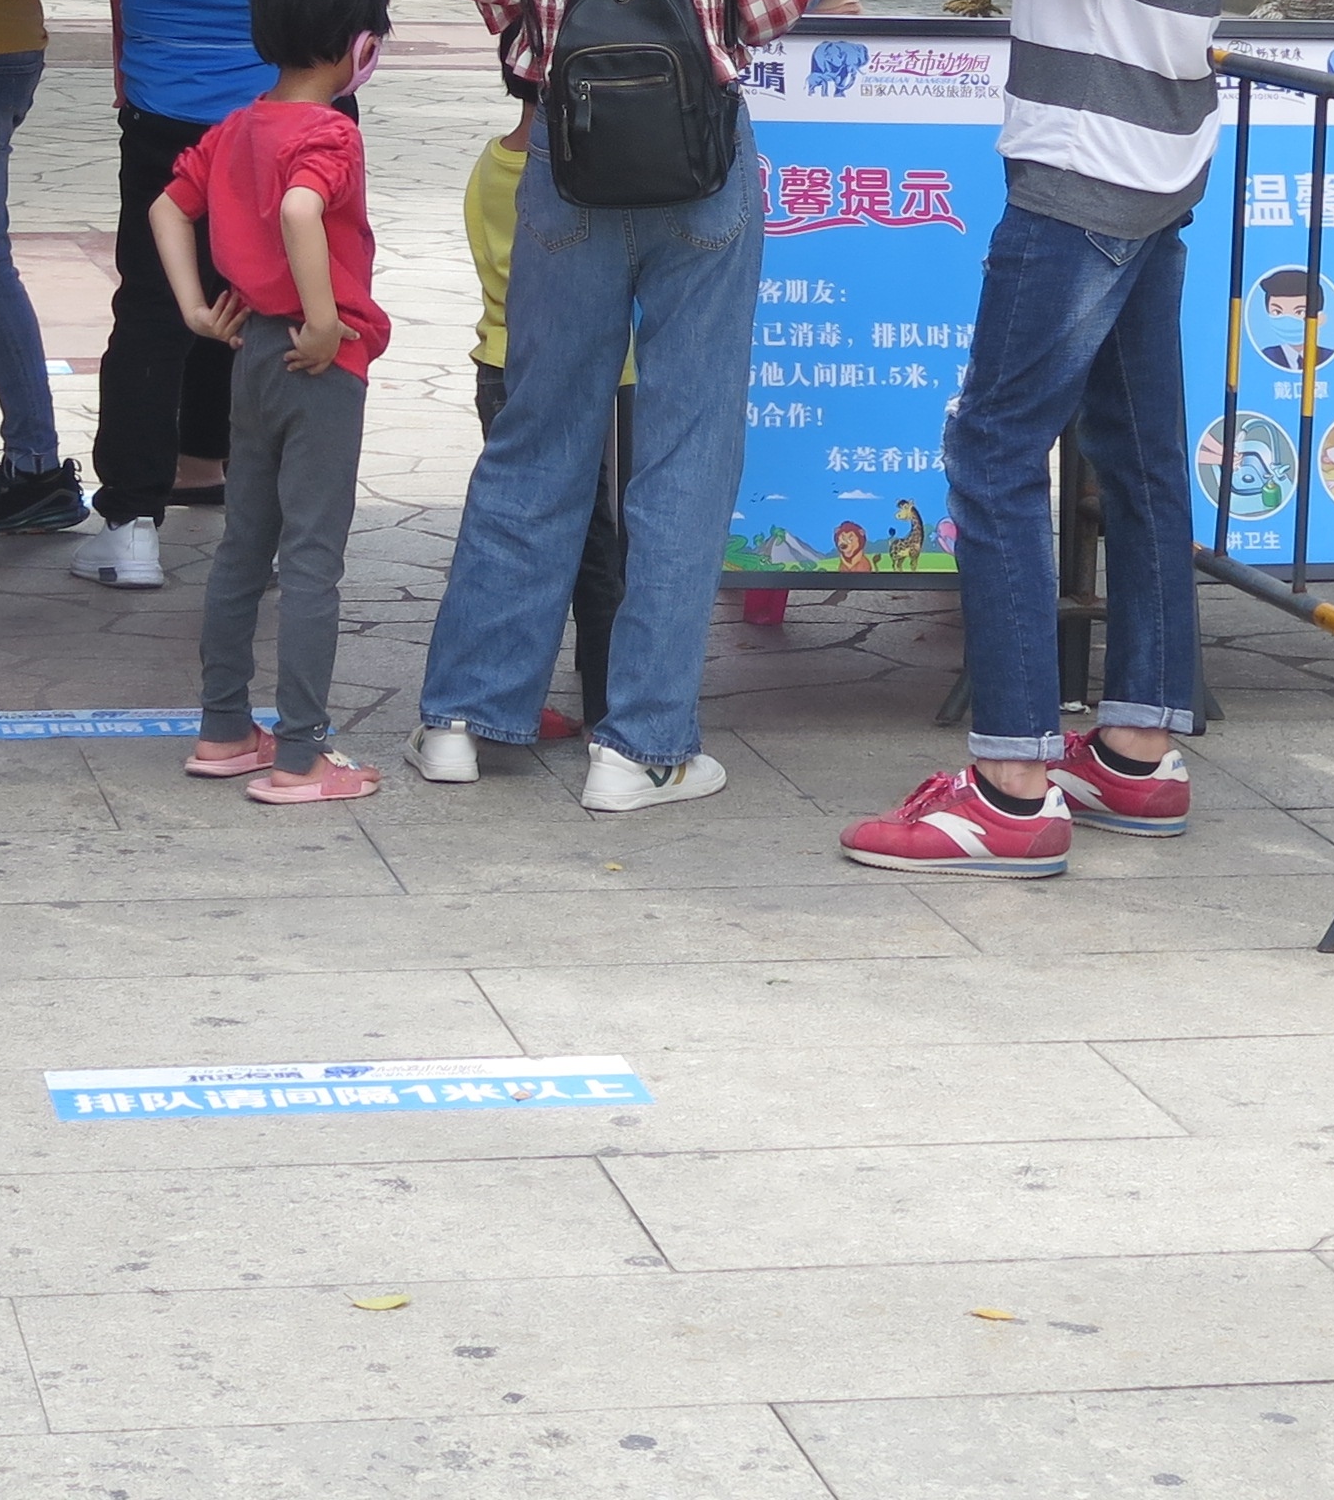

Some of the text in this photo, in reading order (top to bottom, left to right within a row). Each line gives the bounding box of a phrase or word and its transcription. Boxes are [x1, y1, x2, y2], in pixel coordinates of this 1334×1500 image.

[869, 49, 991, 77] 东莞香市动物园
[860, 83, 1002, 99] 国家AAAA级旅游景区
[759, 163, 953, 219] 馨提示
[75, 1078, 634, 1115] 排队请间隔1米以上
